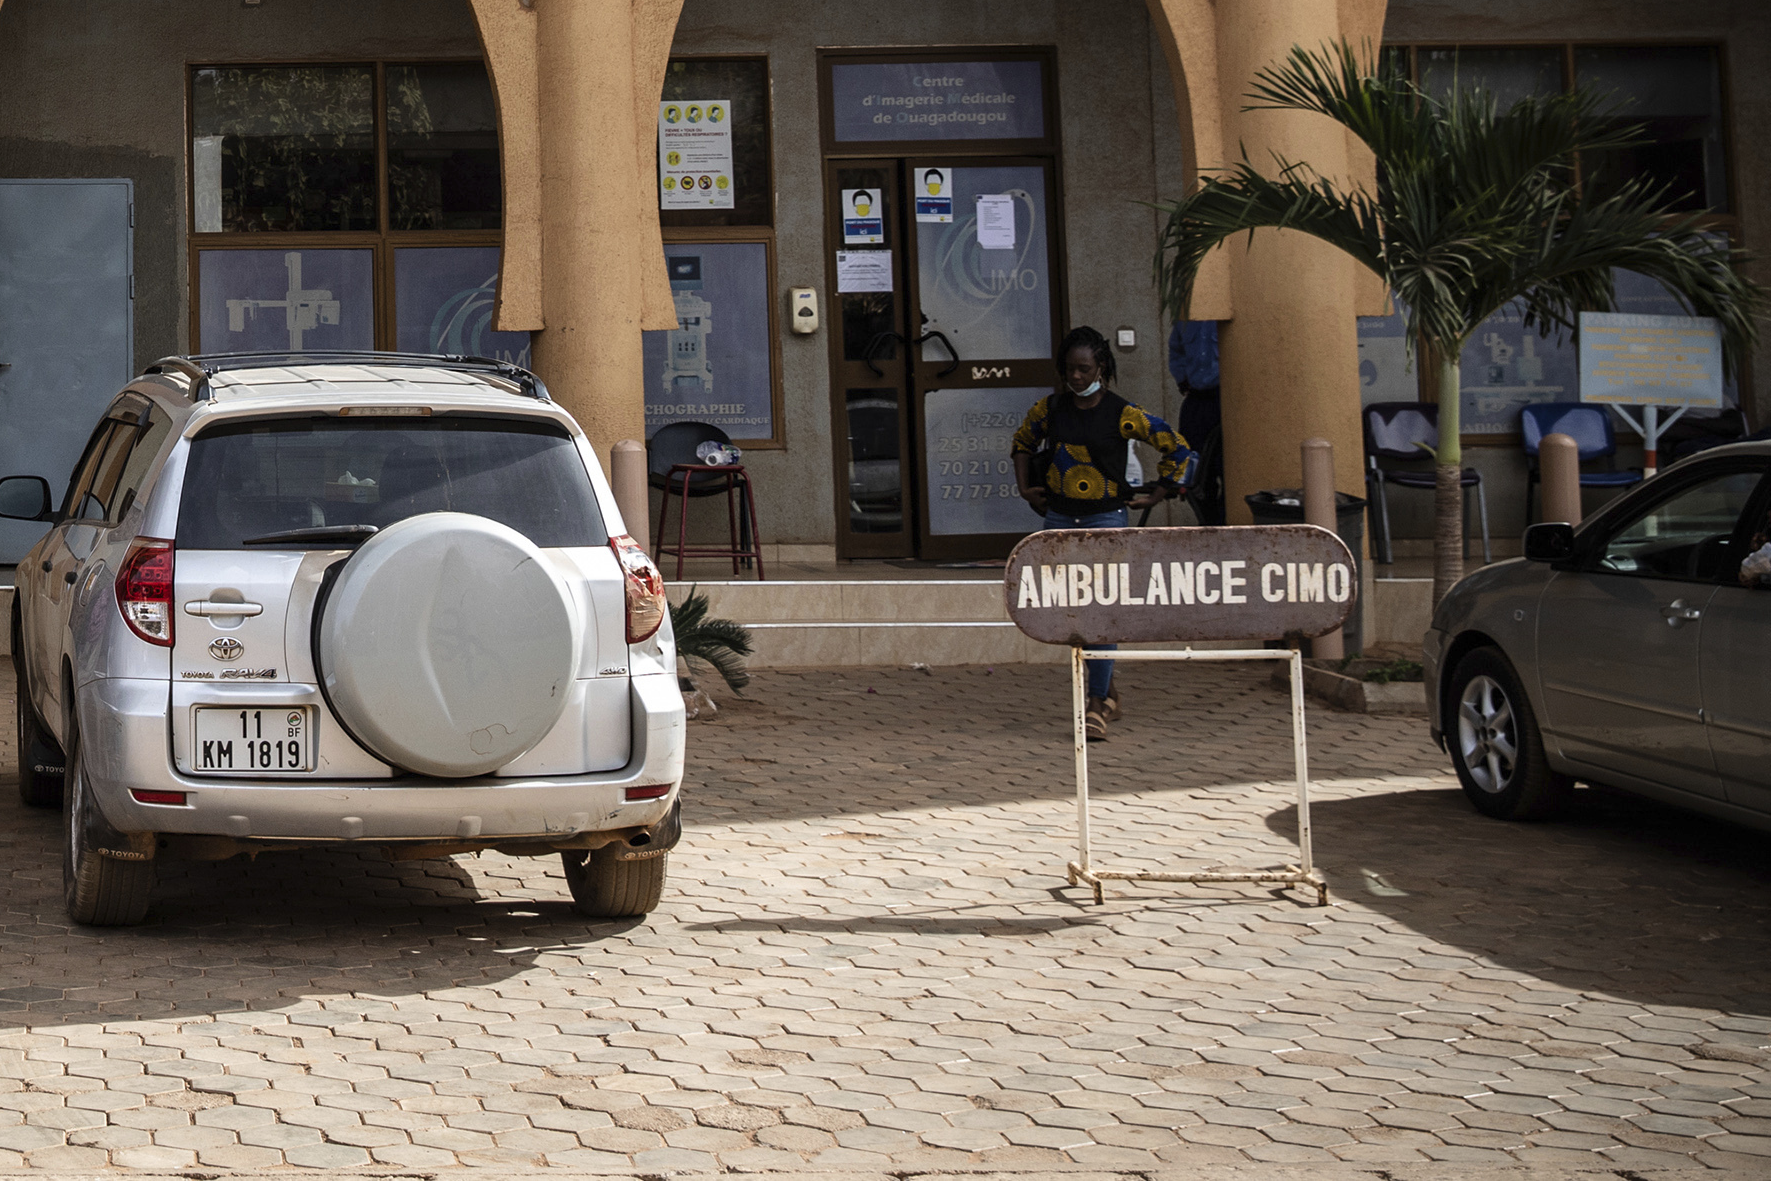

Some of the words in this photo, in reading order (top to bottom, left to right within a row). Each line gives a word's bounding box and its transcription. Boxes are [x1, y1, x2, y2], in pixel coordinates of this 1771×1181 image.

[913, 76, 964, 87] Centre
[873, 112, 892, 124] de
[896, 111, 1007, 126] Ouagadougou
[645, 403, 746, 416] CHOGRAPHIE
[938, 437, 962, 452] 25
[939, 460, 963, 476] 70
[968, 460, 990, 475] 21
[941, 484, 964, 499] 77
[969, 484, 993, 498] 77
[1017, 560, 1248, 609] AMBULANCE
[1261, 562, 1351, 603] CIMO
[180, 671, 215, 679] TOYOTA
[219, 667, 278, 680] RAV4
[239, 710, 262, 739] 11
[287, 727, 301, 738] BF
[203, 740, 233, 768] KM
[247, 740, 300, 768] 1819
